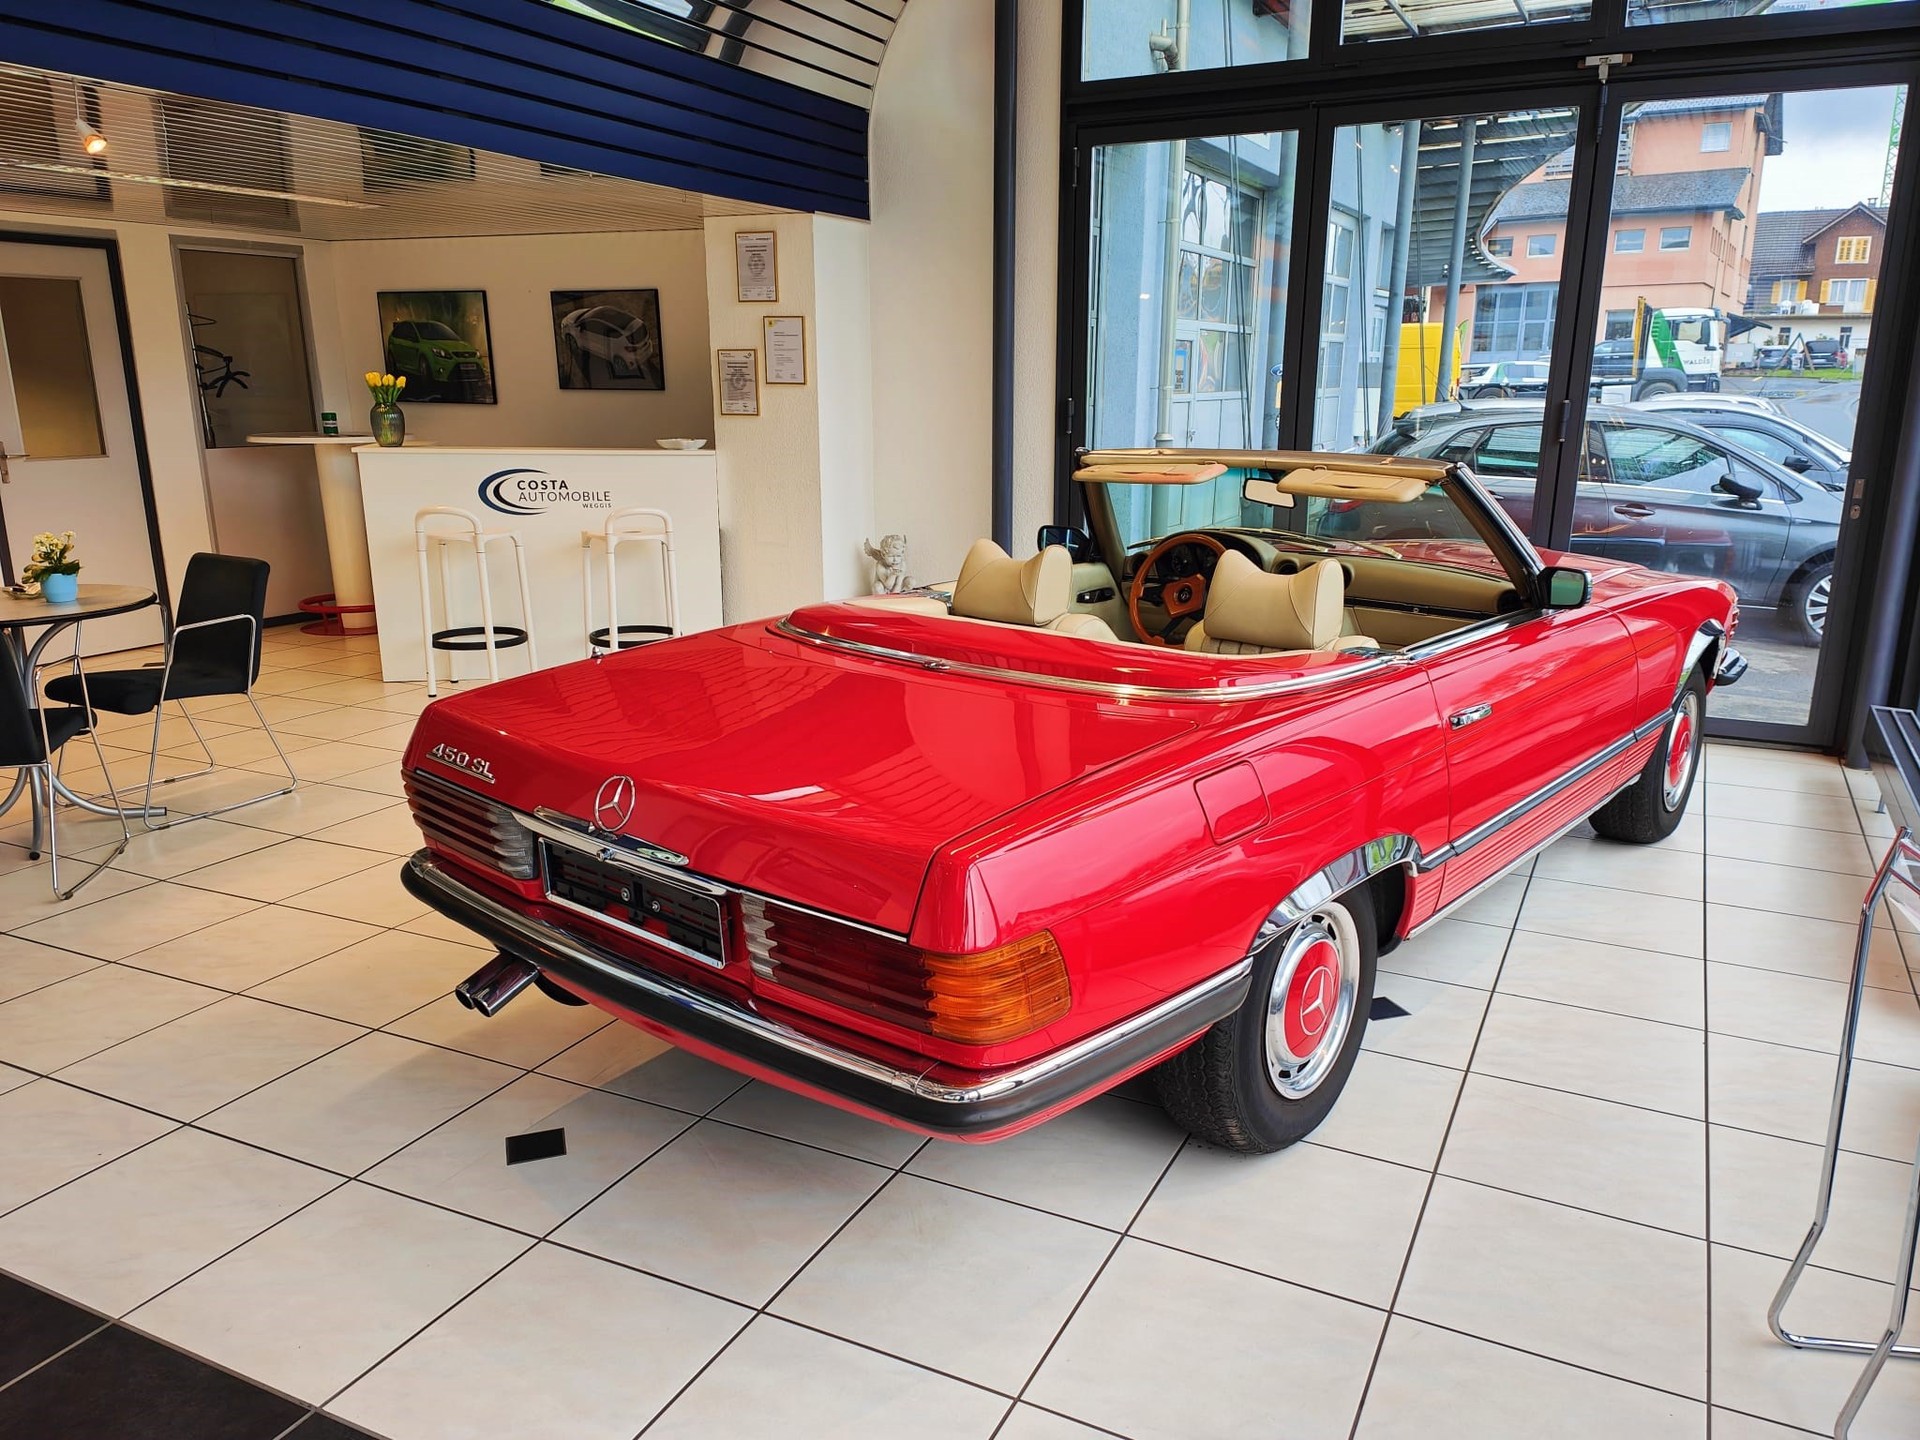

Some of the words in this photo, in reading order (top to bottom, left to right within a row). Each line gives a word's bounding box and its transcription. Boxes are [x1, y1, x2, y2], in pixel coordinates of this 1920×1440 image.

[517, 480, 568, 490] COSTA
[519, 491, 611, 502] AUTOMOBILE
[432, 743, 470, 767] 450
[471, 757, 494, 778] SL
